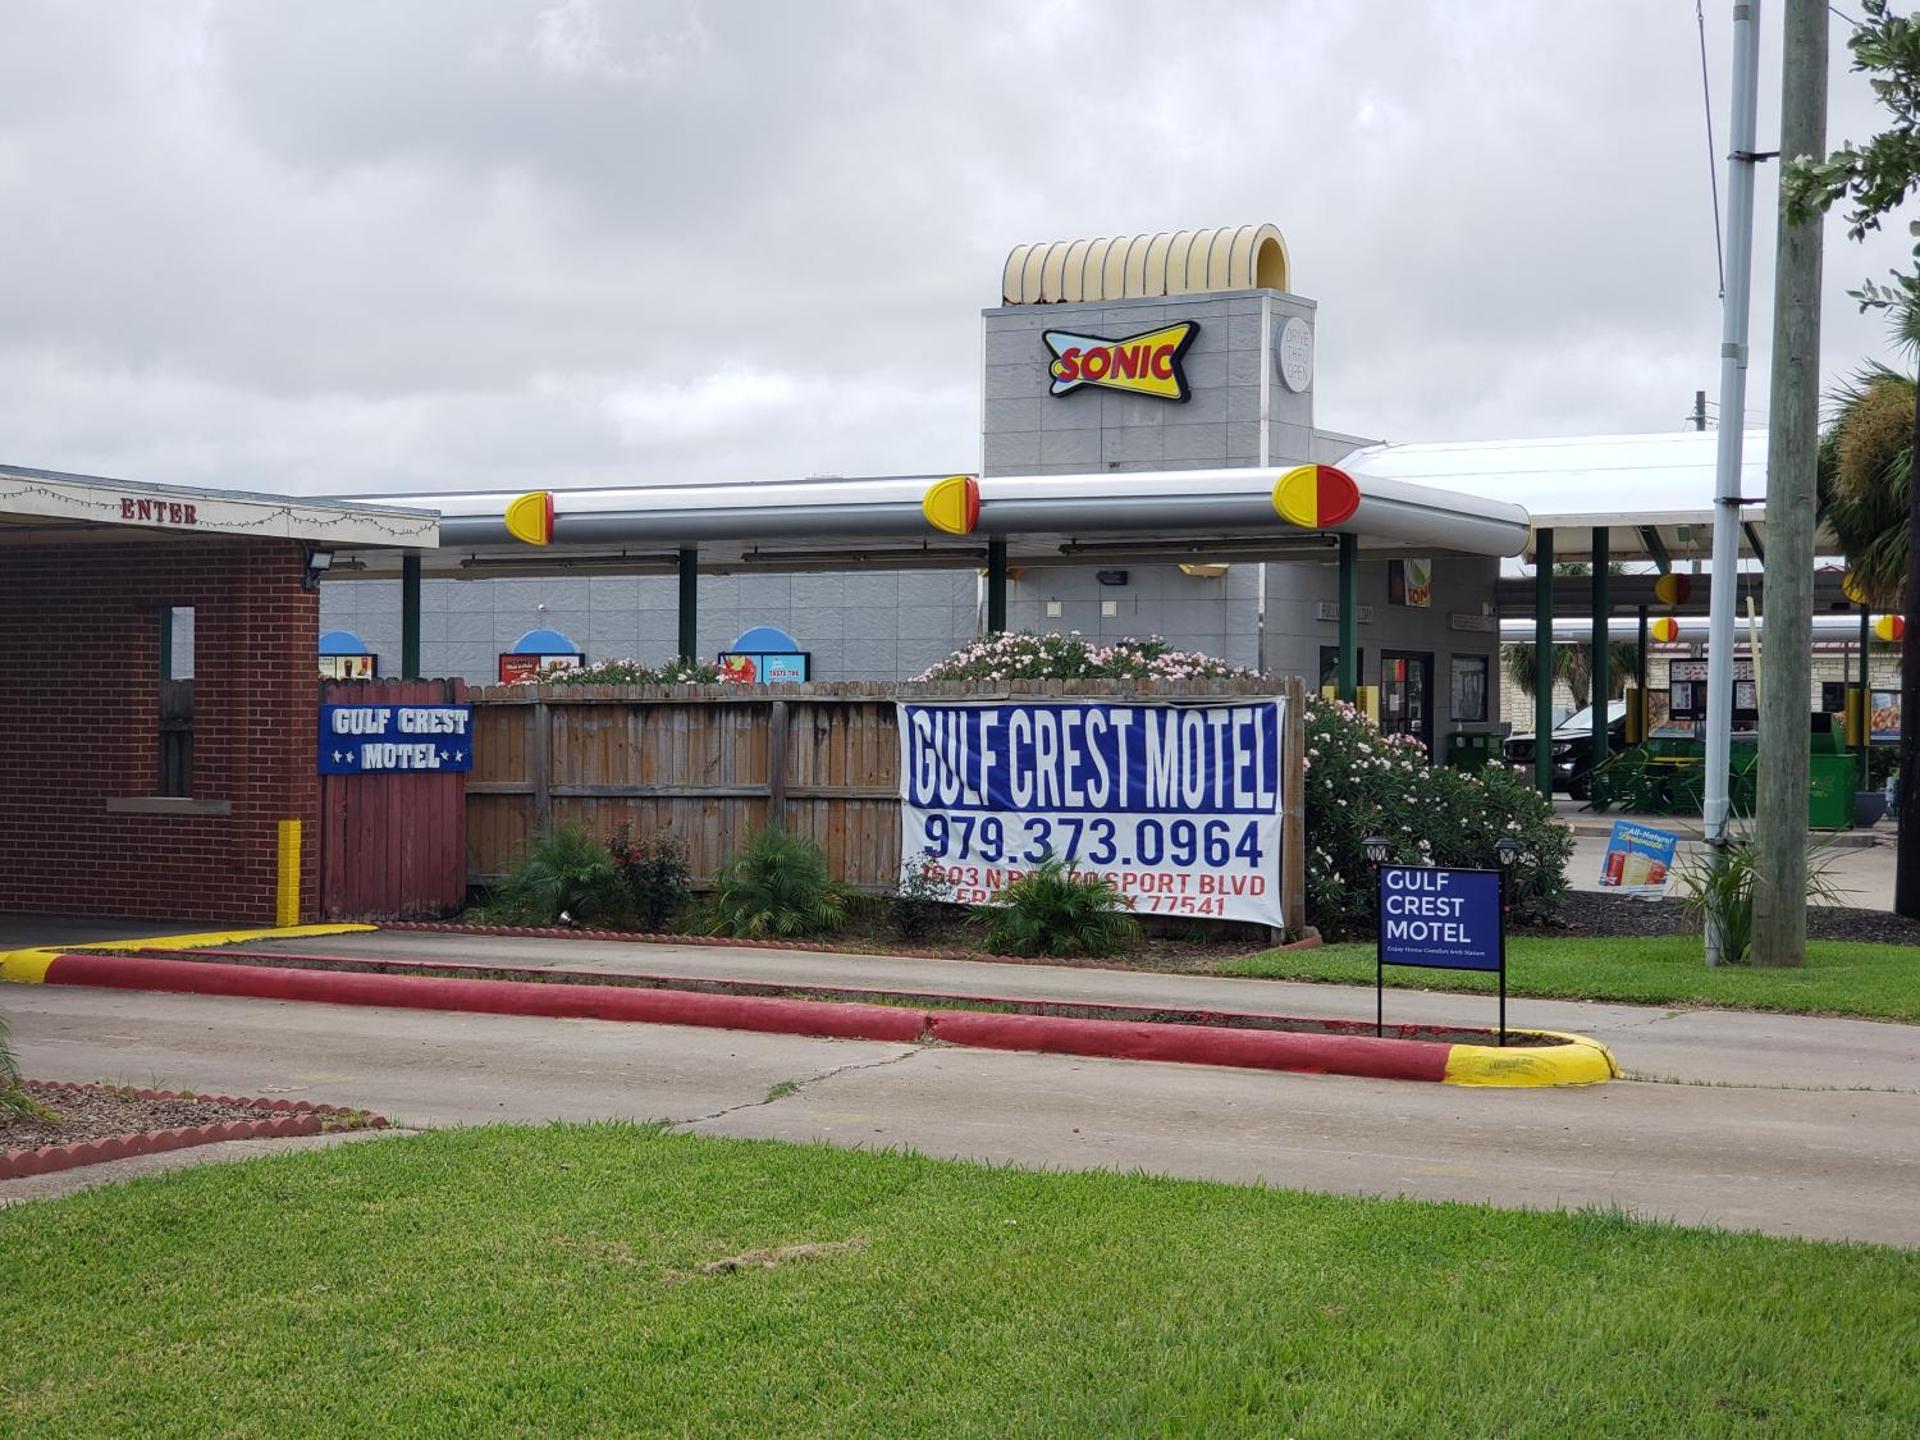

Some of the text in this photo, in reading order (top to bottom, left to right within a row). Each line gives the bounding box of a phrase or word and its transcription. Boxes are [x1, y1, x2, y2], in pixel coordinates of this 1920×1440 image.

[1057, 344, 1175, 383] SONIC
[120, 498, 198, 525] ENTER
[332, 708, 469, 735] GULF CREST
[361, 743, 440, 769] MOTEL
[911, 708, 1275, 809] GULF CREST MOTEL
[924, 814, 1263, 868] 979.373.0964
[986, 869, 1001, 889] N
[1199, 874, 1266, 896] BLVD
[1386, 870, 1449, 892] GULF
[1148, 895, 1225, 916] 77541
[1386, 895, 1464, 917] CREST
[1386, 920, 1471, 943] MOTEL
